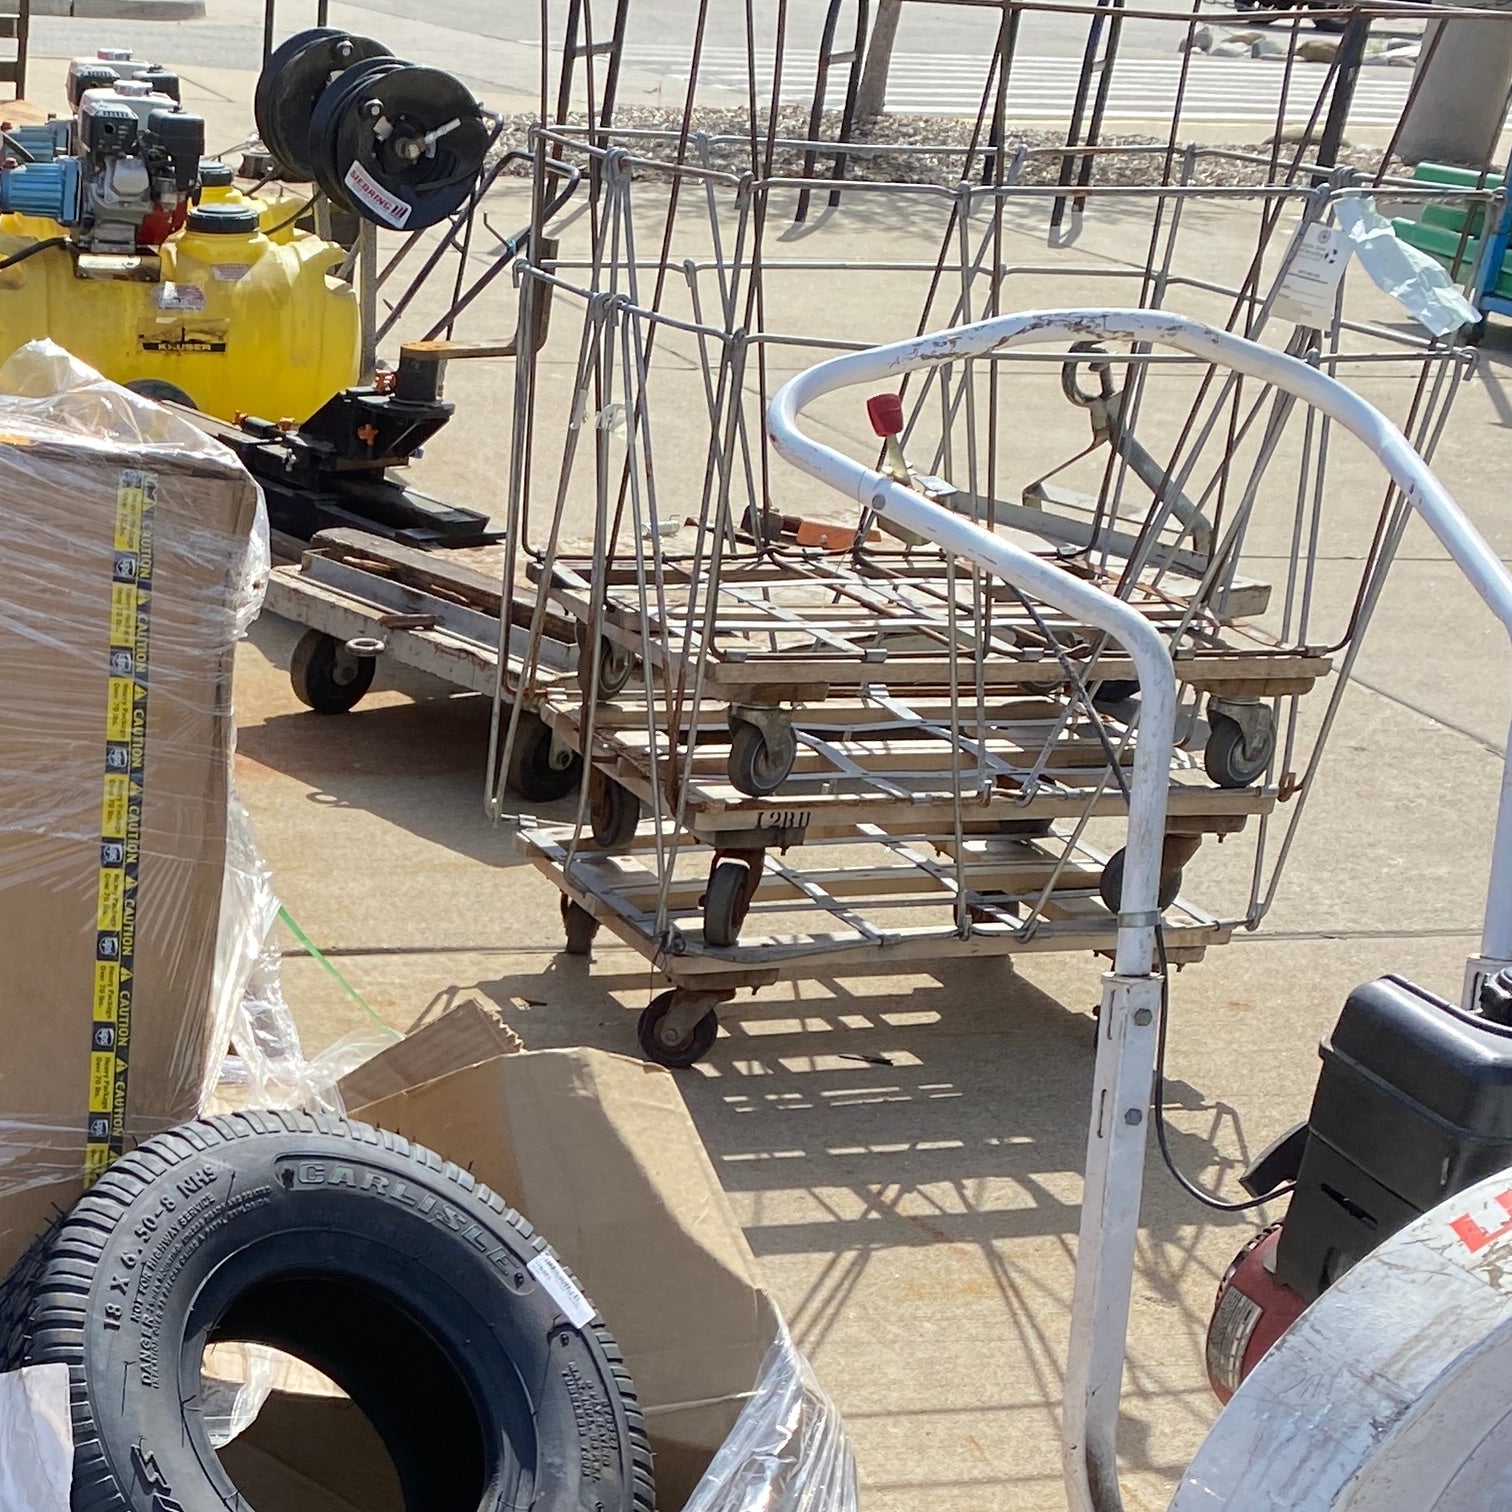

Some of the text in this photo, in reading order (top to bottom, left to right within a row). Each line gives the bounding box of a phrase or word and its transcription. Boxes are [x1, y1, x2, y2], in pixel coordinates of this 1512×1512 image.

[135, 614, 148, 673] CAUTION
[132, 709, 145, 767] CAUTION
[126, 805, 140, 864] CAUTION
[122, 899, 136, 956] CAUTION
[118, 991, 131, 1046] CAUTION
[112, 1081, 126, 1136] CAUTION
[176, 1164, 219, 1200] NHS
[297, 1160, 520, 1276] CARLISLE
[110, 1272, 131, 1297] X
[130, 1290, 144, 1324] NOT
[140, 1264, 154, 1296] FOR
[148, 1223, 181, 1270] HIGHWAY
[178, 1192, 216, 1227] SERVICE
[103, 1301, 124, 1332] 18
[138, 1308, 157, 1389] DANGER
